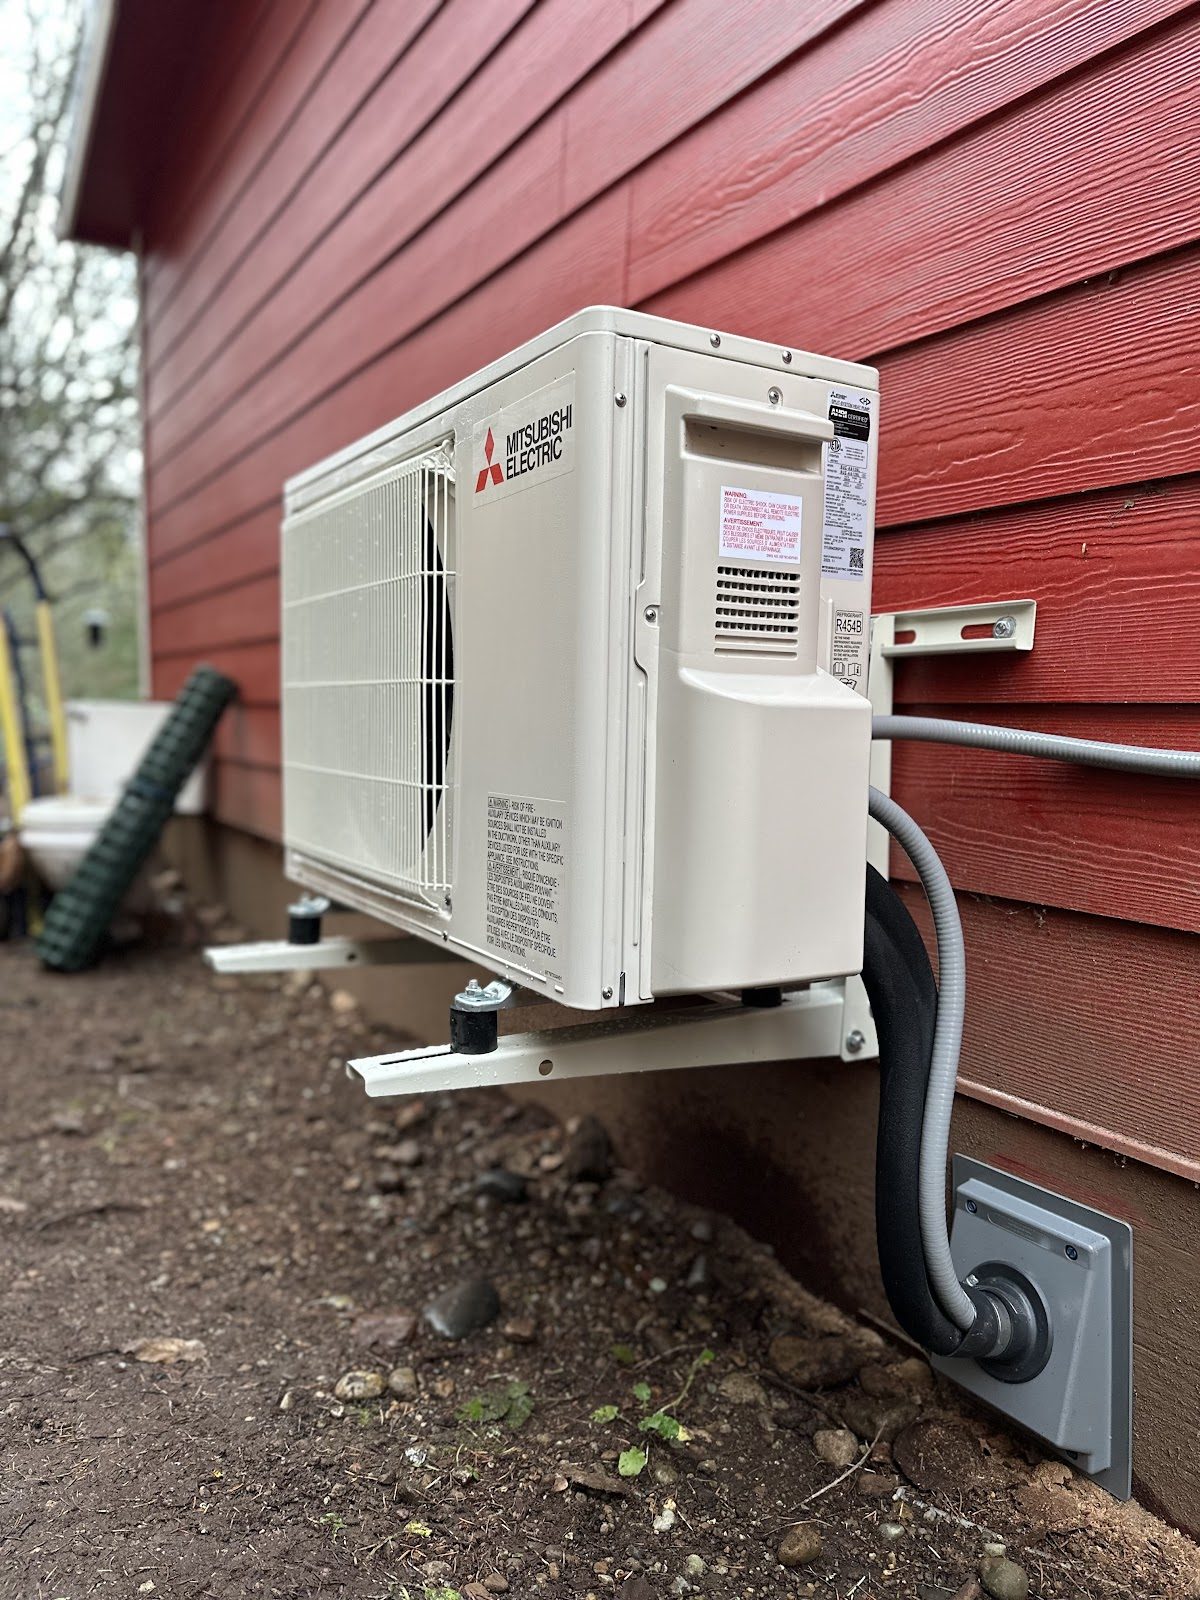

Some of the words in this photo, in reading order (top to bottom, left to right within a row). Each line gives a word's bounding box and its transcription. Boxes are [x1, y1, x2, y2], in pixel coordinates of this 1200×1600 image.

[506, 403, 572, 457] MITSUBISHI
[506, 435, 563, 480] ELECTRIC
[836, 619, 862, 633] R454B
[511, 801, 519, 811] RISK
[488, 819, 504, 830] SOURCES
[504, 822, 513, 832] SHALL
[527, 826, 546, 839] INSTALLED
[505, 811, 518, 822] DEVICES
[519, 814, 530, 824] WHICH
[531, 816, 539, 825] MAY
[545, 818, 562, 829] IGNITION
[488, 840, 501, 851] DEVICES
[502, 843, 512, 854] LISTED
[529, 849, 538, 859] WITH
[546, 853, 564, 866] SPECIFIC
[519, 836, 530, 846] OTHER
[531, 838, 540, 849] THAN
[541, 840, 560, 853] AUXILIARY
[523, 870, 535, 881] RISQUE
[494, 874, 513, 887] DISPOSITIFS
[535, 885, 552, 898] POUVANT
[503, 887, 518, 899] SOURCES
[538, 897, 554, 910] DOIVENT
[520, 902, 530, 914] DANS
[518, 913, 539, 929] DISPOSITIFS
[501, 929, 509, 940] AVEC
[515, 934, 534, 950] DISPOSITIF
[530, 928, 540, 941] POUR
[541, 930, 551, 945] ÊTRE
